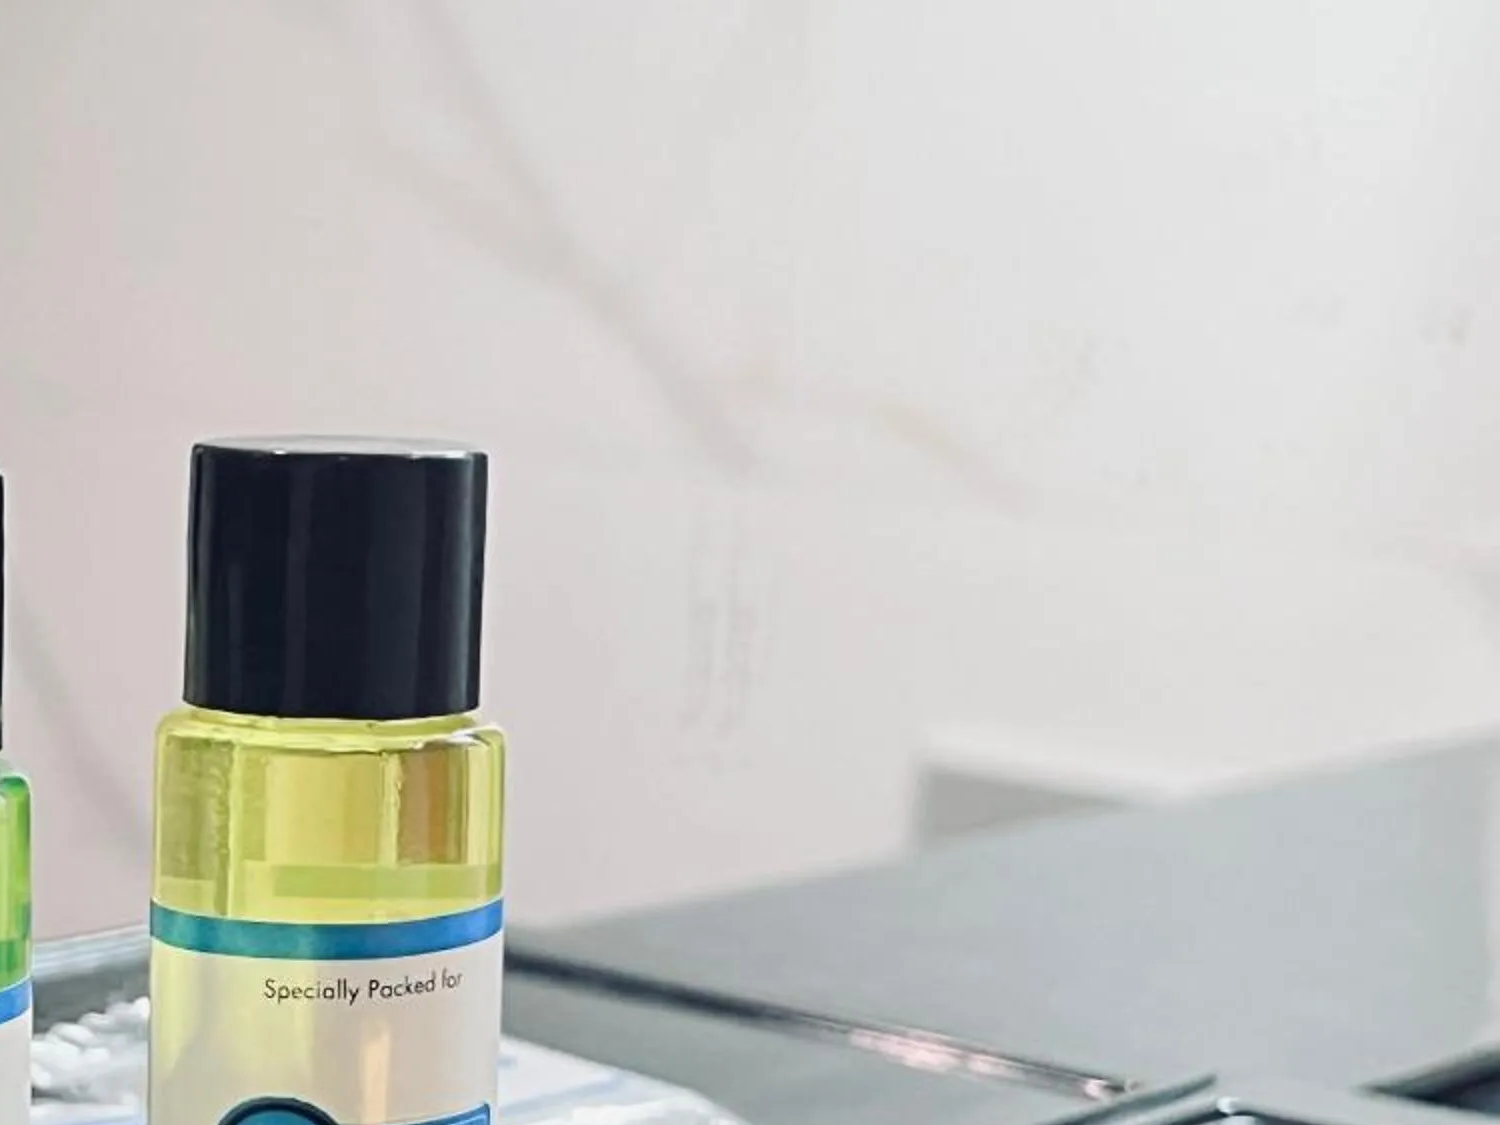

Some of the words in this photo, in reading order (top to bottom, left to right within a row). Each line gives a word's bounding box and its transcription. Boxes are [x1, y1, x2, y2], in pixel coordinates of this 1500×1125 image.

[264, 977, 360, 1006] Specially
[368, 971, 436, 999] Packed
[441, 967, 464, 989] for
